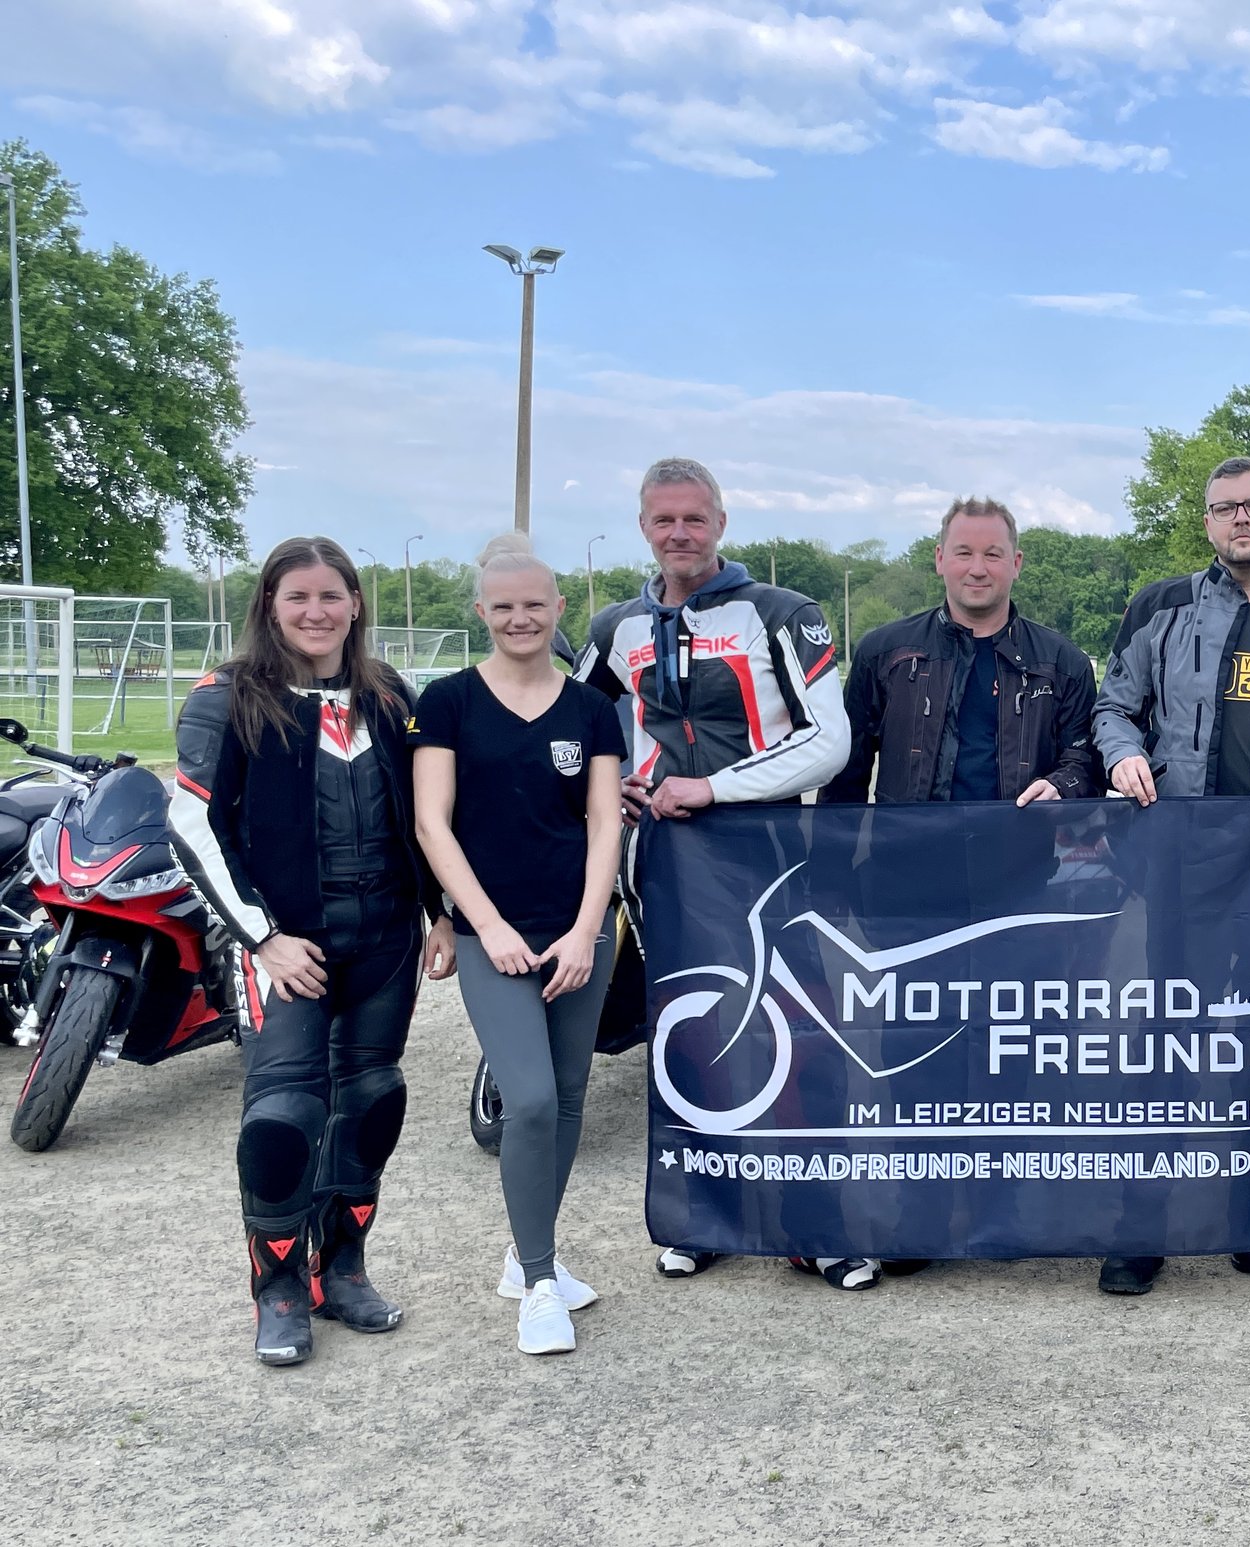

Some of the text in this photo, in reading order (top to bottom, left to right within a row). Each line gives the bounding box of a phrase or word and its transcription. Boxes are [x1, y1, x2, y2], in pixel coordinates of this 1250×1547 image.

[843, 972, 1201, 1021] MOTORRAD
[849, 1104, 880, 1125] IM
[895, 1102, 1051, 1124] LEIPZIGER
